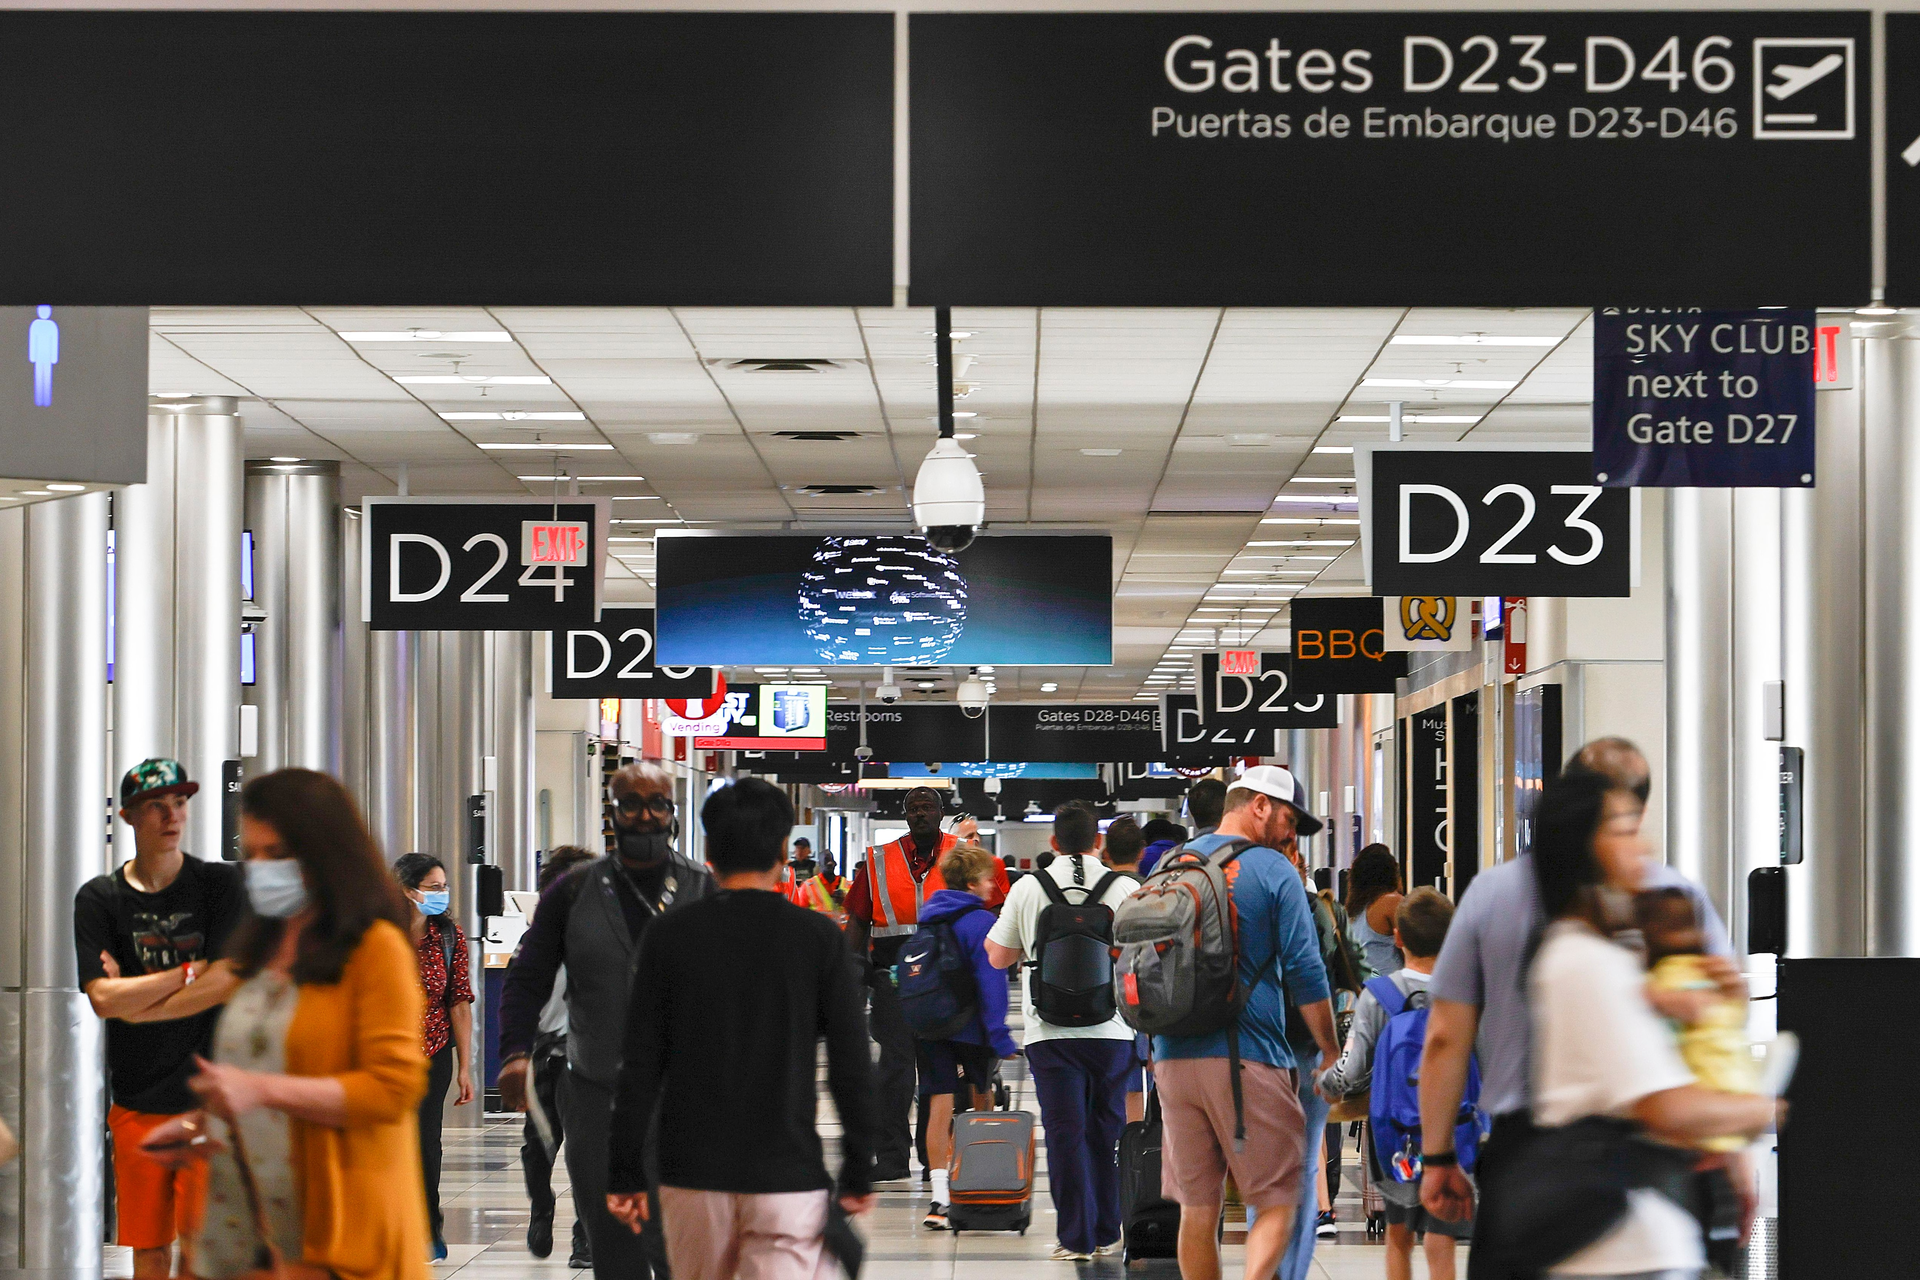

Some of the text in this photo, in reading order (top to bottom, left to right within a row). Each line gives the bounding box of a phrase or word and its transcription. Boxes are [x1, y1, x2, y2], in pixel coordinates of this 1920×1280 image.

[1164, 35, 1736, 94] Gates D23-D46
[1152, 107, 1738, 143] Puertas de Embarque D23-D46
[1626, 324, 1809, 354] SKY CLUB
[1627, 370, 1758, 398] next to
[1627, 413, 1798, 444] Gate D27
[1399, 483, 1604, 566] D23
[531, 526, 580, 561] EXIT
[567, 628, 697, 680] D2
[1298, 630, 1387, 661] BBQ
[1225, 651, 1255, 674] EXIT
[670, 722, 720, 734] Vending
[826, 710, 902, 722] Restrooms
[1038, 710, 1150, 722] Gates D28-D46
